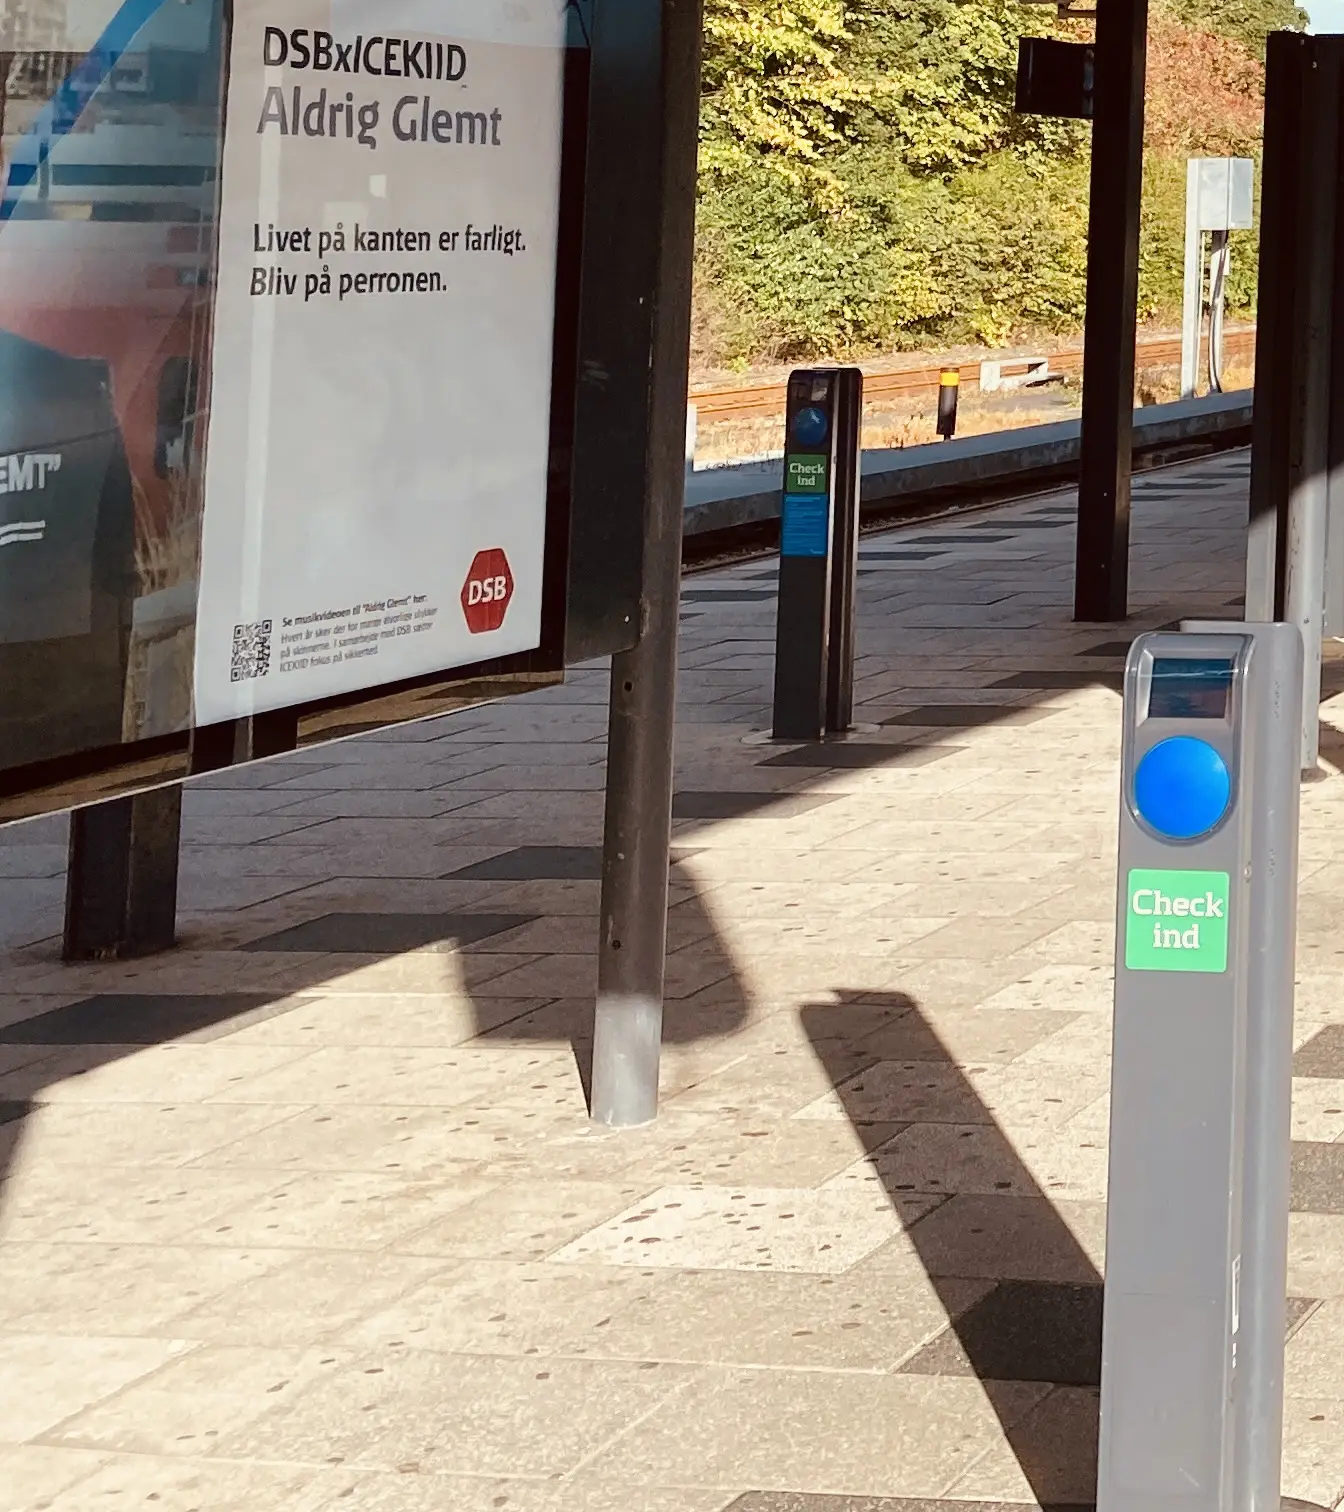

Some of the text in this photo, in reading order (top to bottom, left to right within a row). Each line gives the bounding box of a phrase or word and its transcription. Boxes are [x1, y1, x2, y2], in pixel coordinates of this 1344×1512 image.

[263, 26, 467, 82] DSBxICEKIID
[257, 85, 502, 150] Aldrig Glemt
[254, 222, 527, 259] Livet på kanten er farligt.
[250, 265, 447, 302] Bliv på perronen.
[790, 463, 825, 474] Check
[797, 475, 816, 486] ind
[468, 576, 507, 605] DSB
[282, 616, 293, 628] Se
[1131, 888, 1224, 918] Check
[1152, 923, 1201, 949] ind
